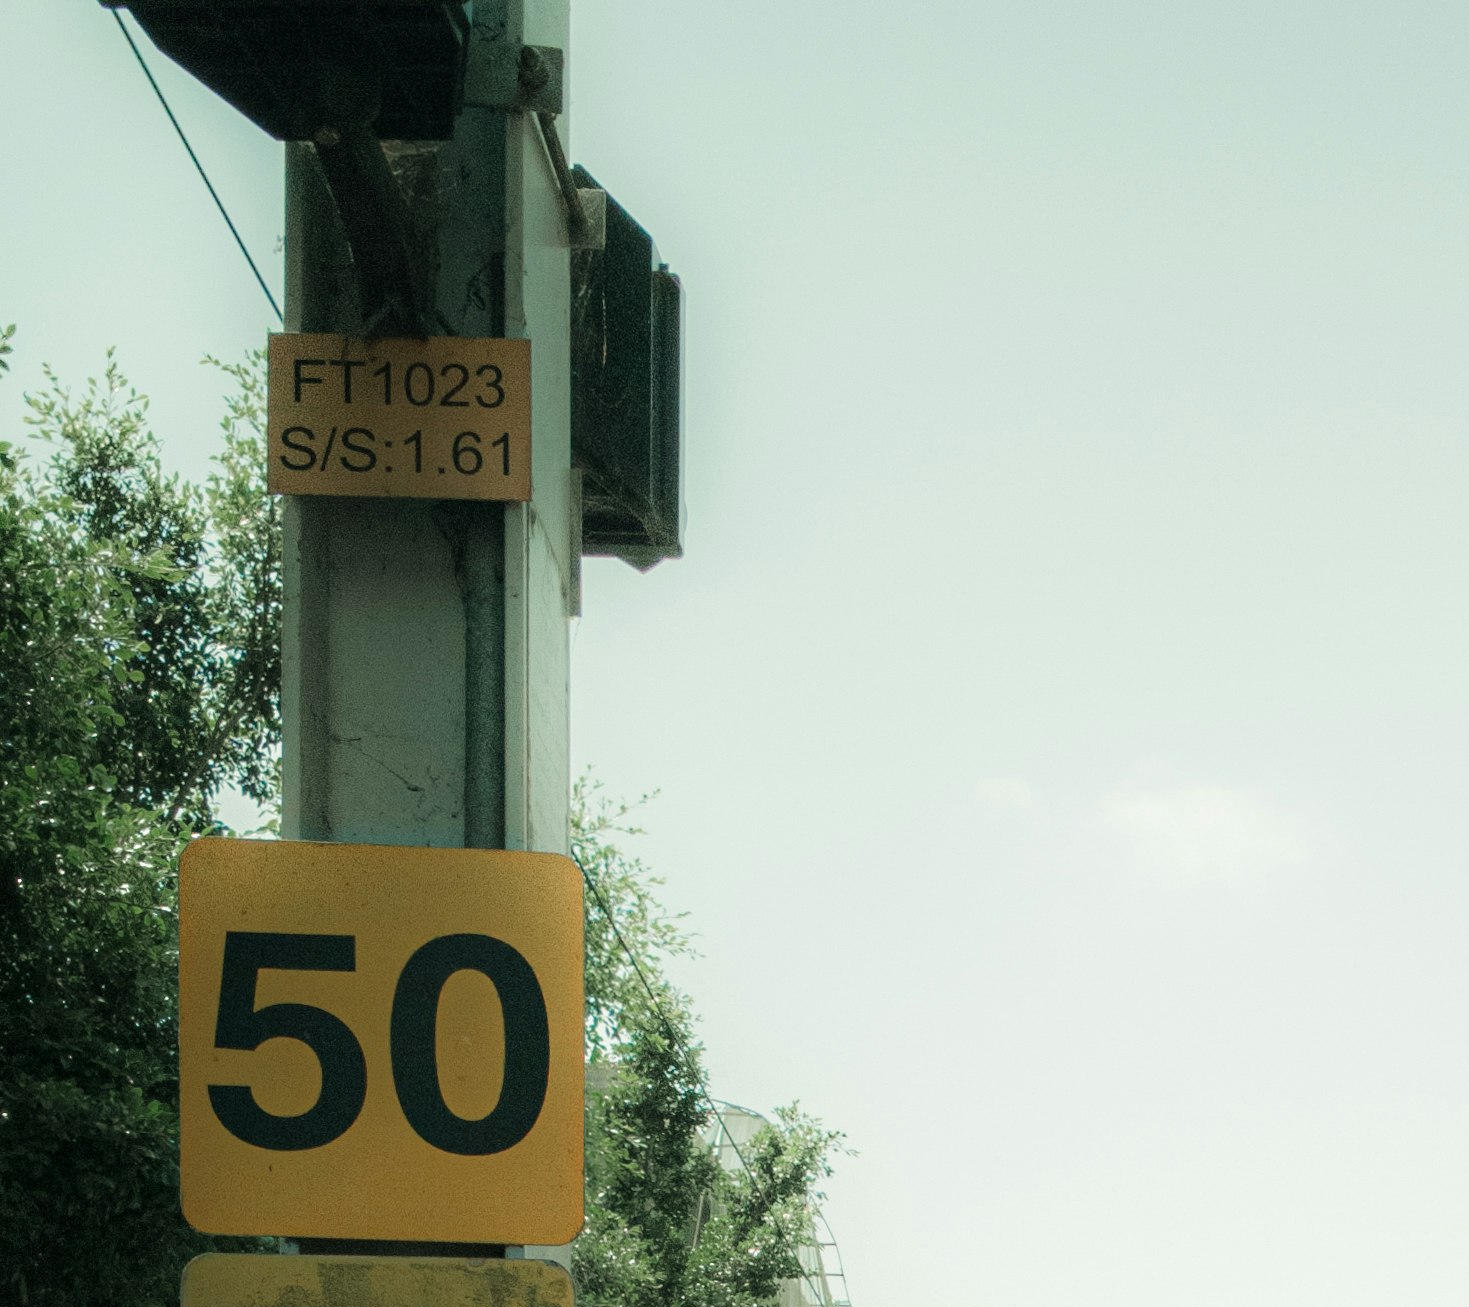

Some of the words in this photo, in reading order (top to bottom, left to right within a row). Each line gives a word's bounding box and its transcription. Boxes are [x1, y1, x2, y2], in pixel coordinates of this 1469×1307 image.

[293, 359, 506, 409] FT1023
[279, 426, 512, 476] S/S:1.61
[207, 931, 550, 1156] 50
